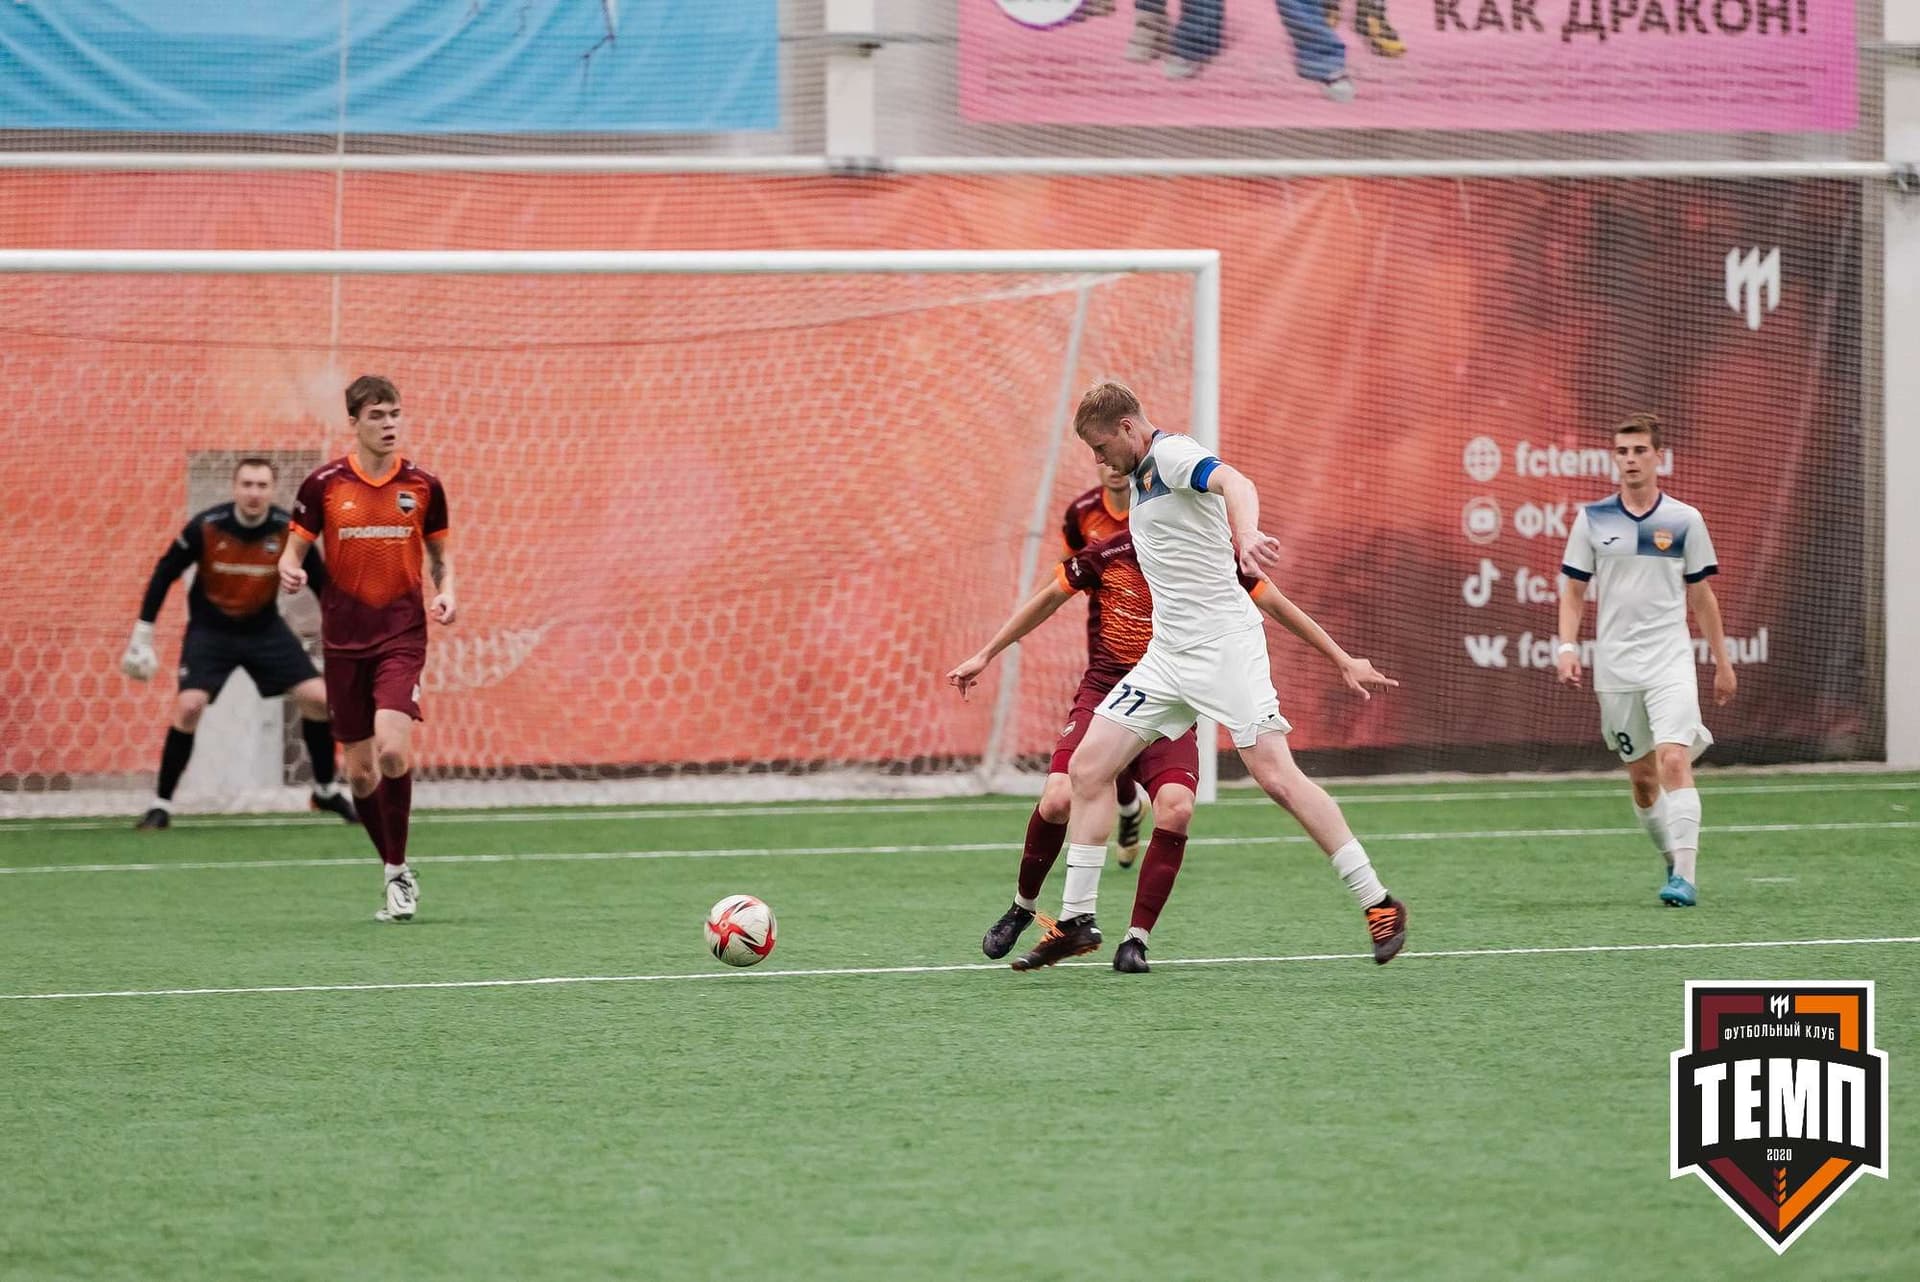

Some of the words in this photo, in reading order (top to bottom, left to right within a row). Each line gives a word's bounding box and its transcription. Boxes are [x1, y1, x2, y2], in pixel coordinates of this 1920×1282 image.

[1434, 0, 1545, 32] КАК
[1561, 0, 1808, 42] ДРАКОН!
[1109, 683, 1147, 716] 77
